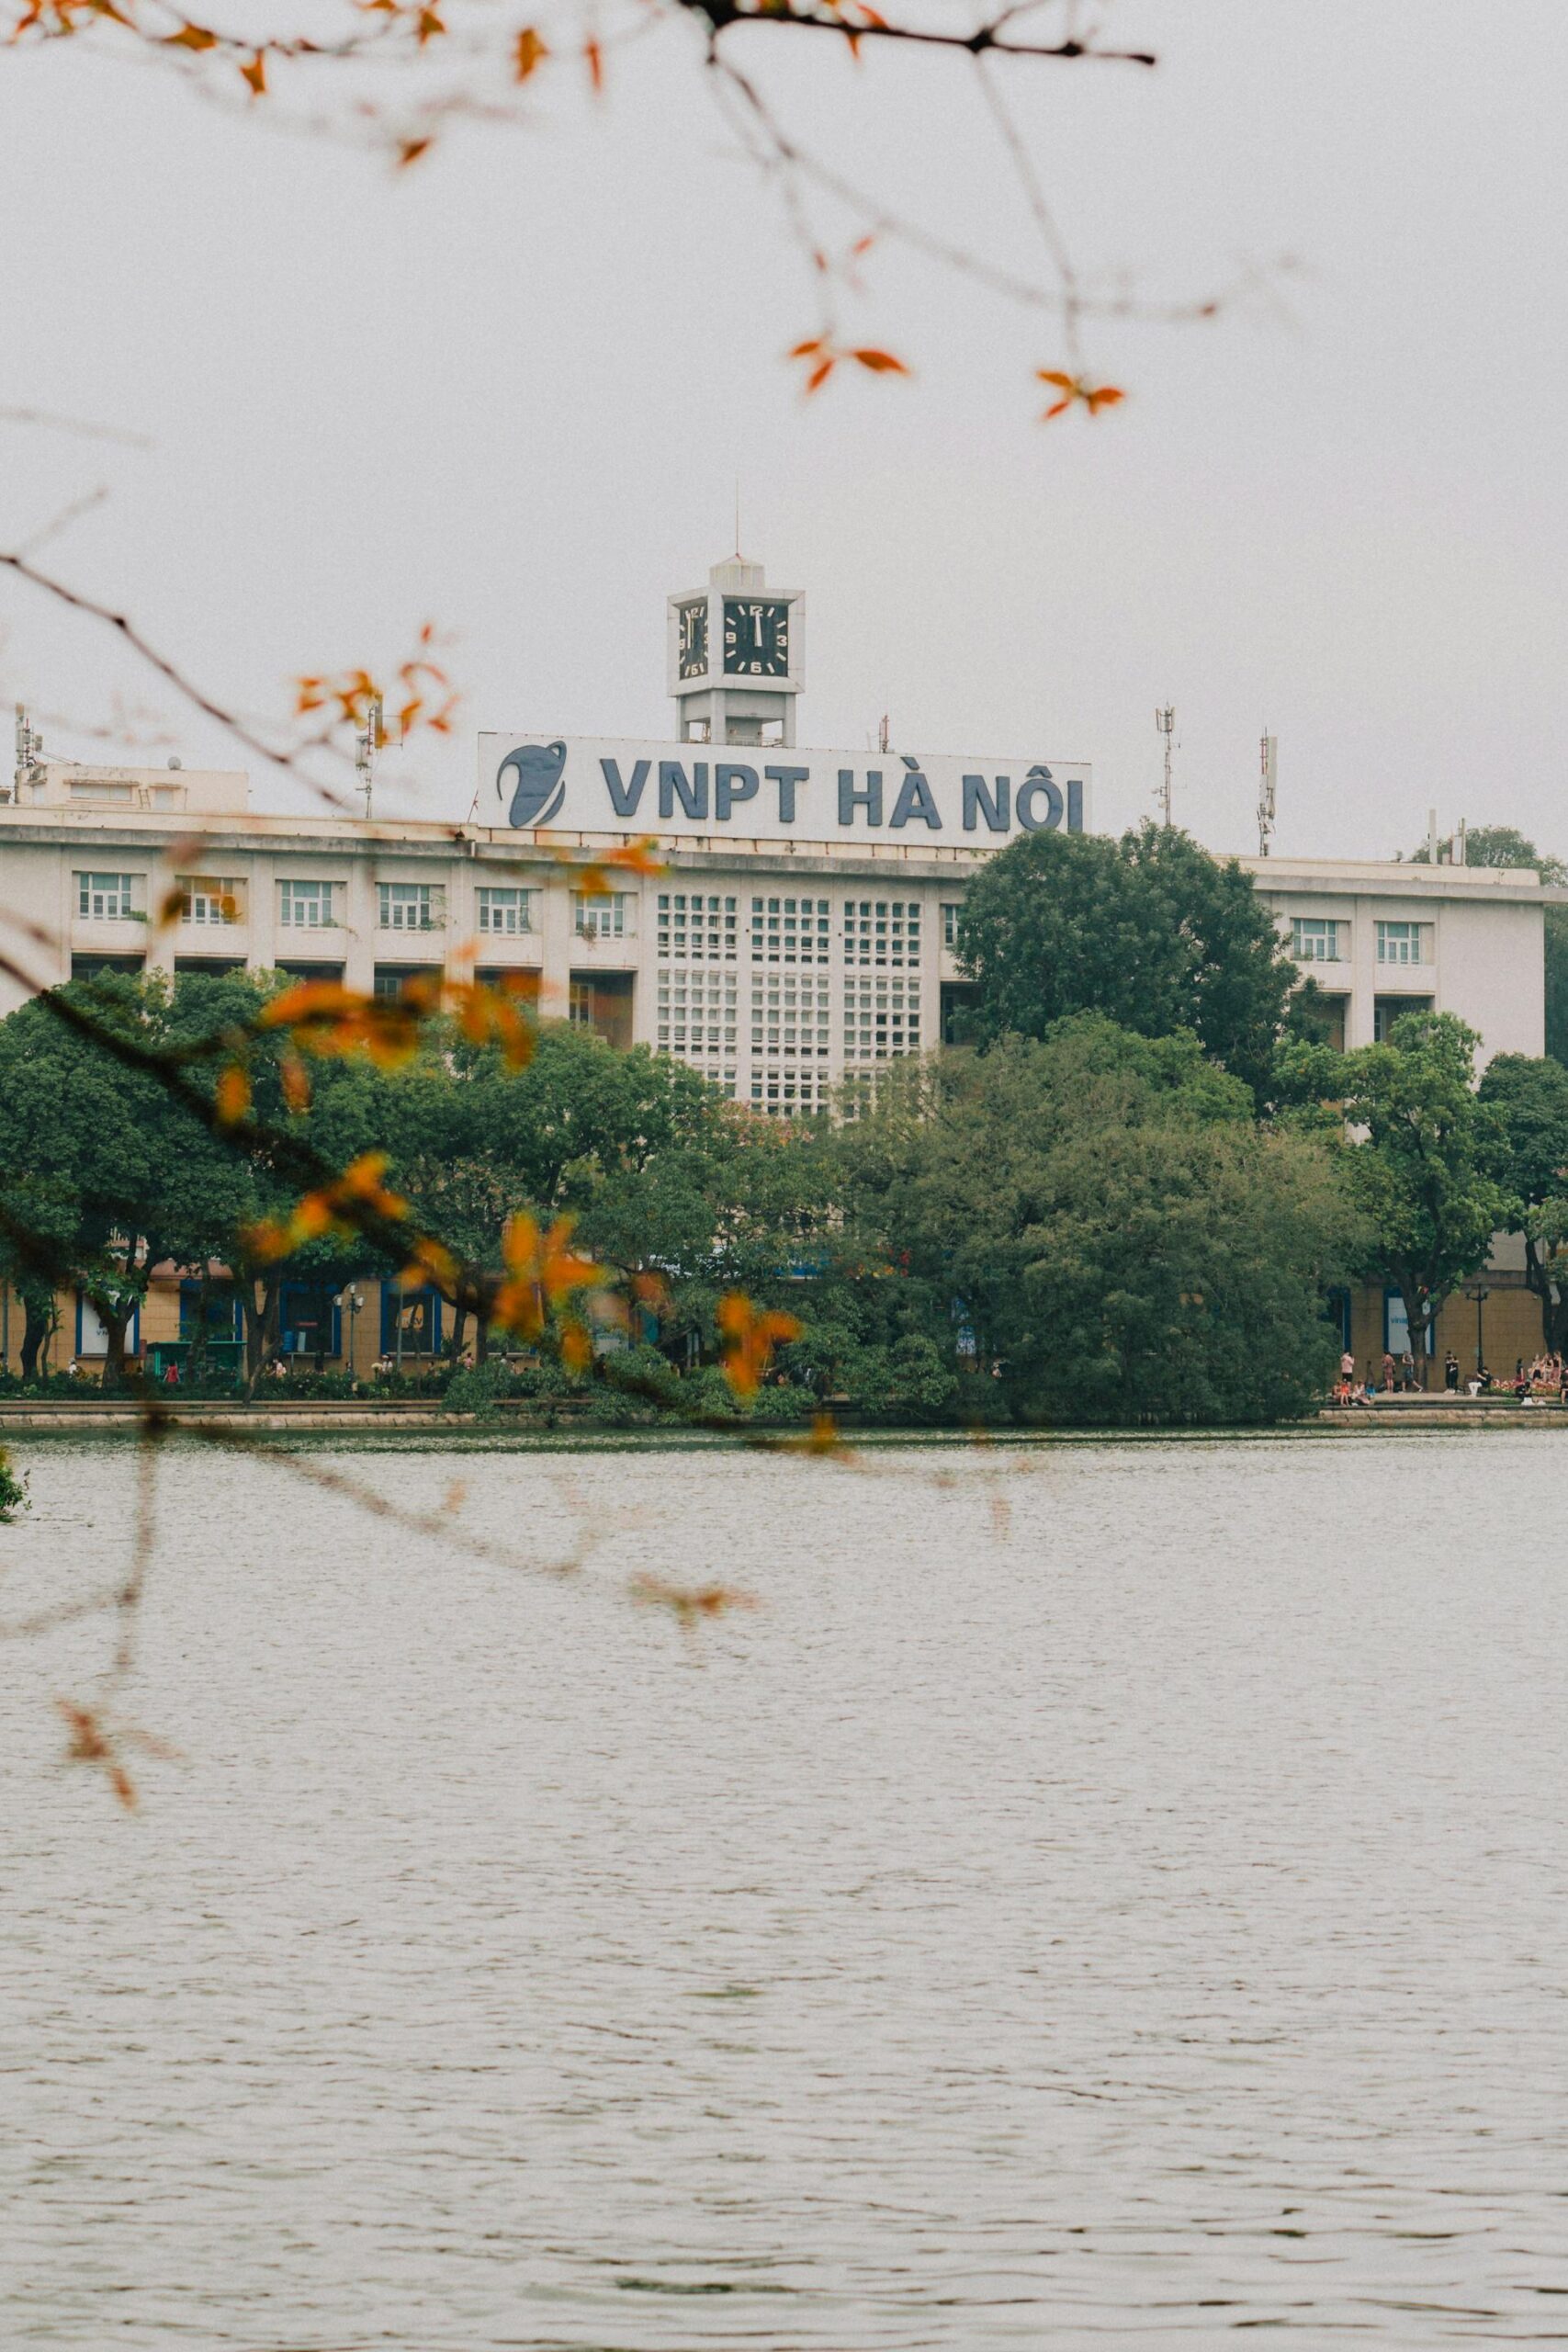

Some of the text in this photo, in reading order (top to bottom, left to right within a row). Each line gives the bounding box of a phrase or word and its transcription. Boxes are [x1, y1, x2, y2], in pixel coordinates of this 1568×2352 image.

[750, 605, 763, 616] 12
[726, 632, 737, 643] 9
[776, 635, 787, 647] 3
[691, 663, 698, 675] 6
[750, 662, 761, 673] 6
[599, 758, 809, 823] VNPT
[838, 756, 942, 829] HÀ
